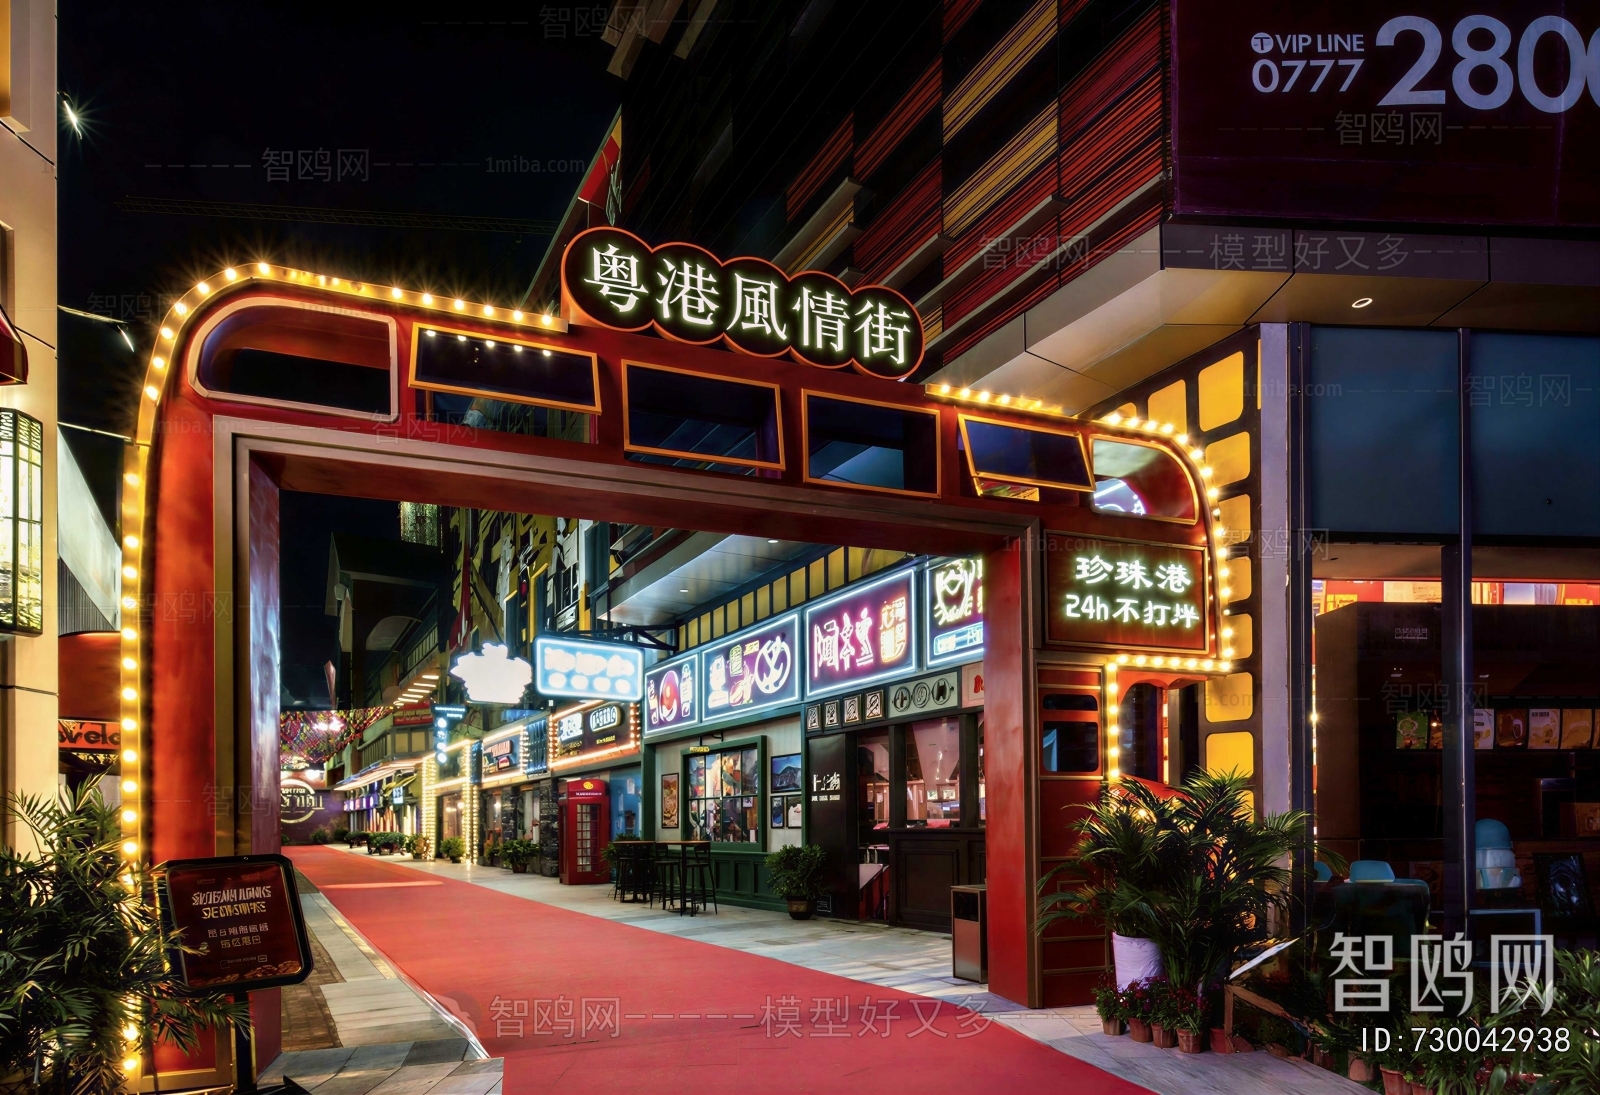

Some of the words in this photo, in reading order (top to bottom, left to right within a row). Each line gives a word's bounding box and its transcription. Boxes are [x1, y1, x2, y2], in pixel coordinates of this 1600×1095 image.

[1251, 58, 1365, 93] 0777
[1375, 14, 1600, 114] 280
[1275, 34, 1312, 53] VIP
[1317, 34, 1365, 53] LINE
[583, 242, 912, 366] 粤港風情街
[1075, 554, 1192, 593] 珍珠港
